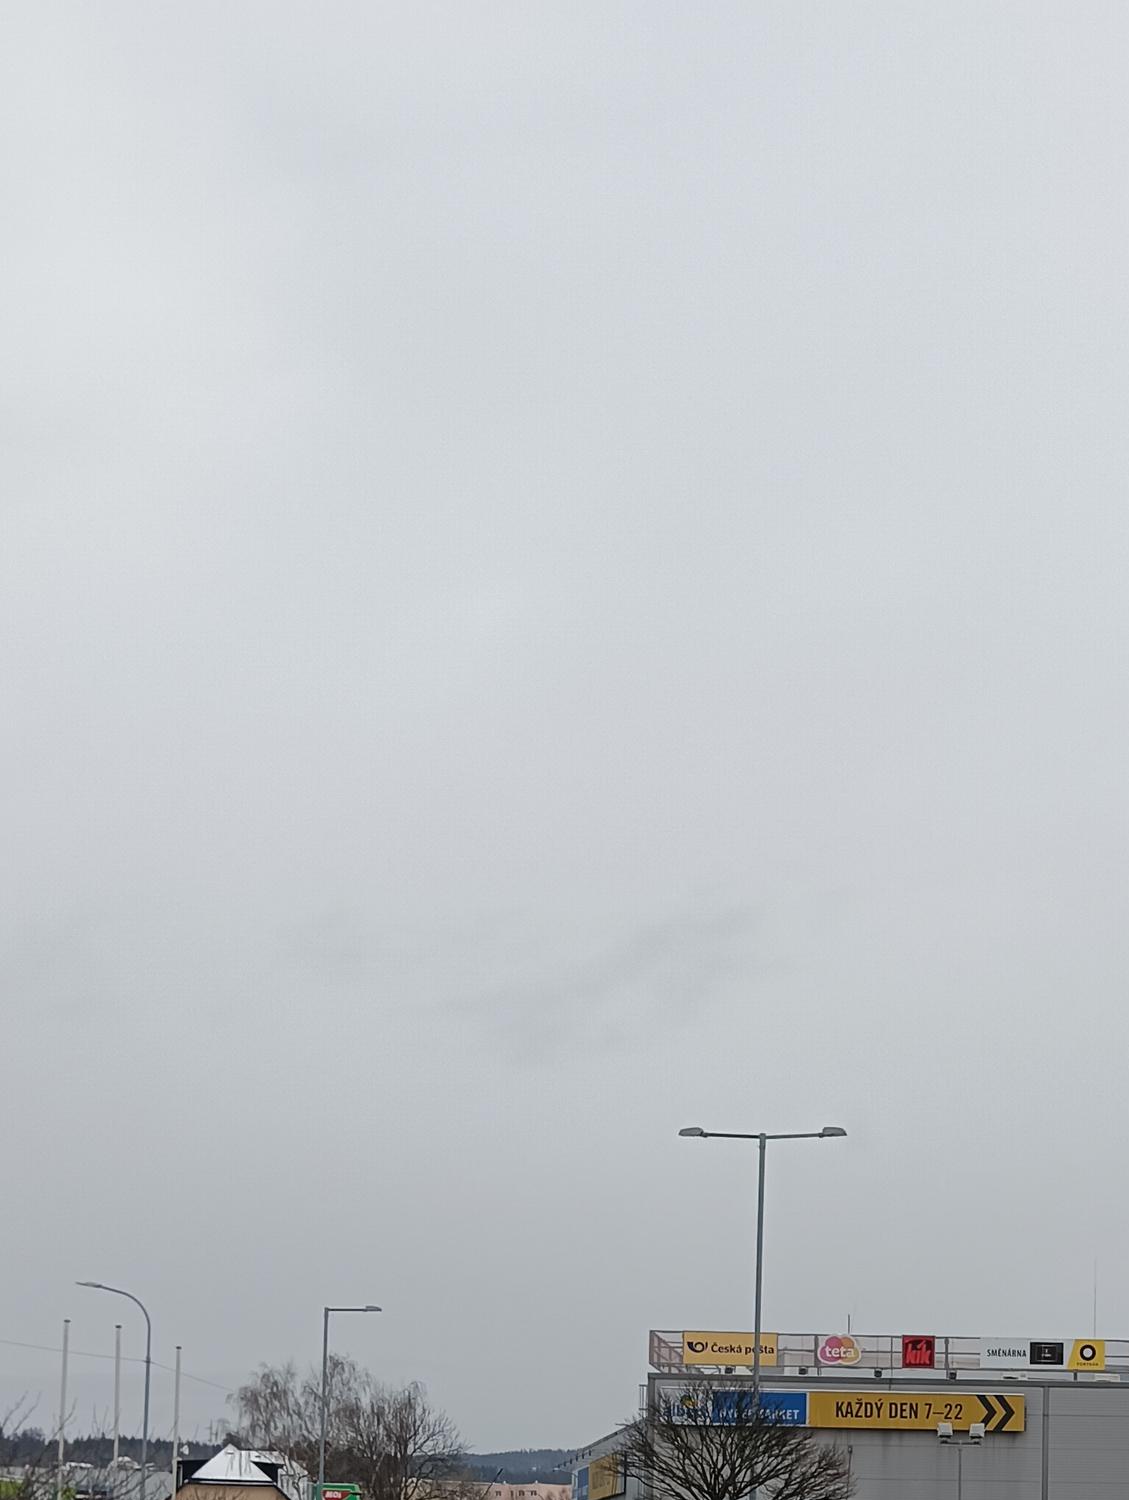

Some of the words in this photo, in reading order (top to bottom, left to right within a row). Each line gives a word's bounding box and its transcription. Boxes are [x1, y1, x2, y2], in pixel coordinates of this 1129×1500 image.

[711, 1342, 742, 1354] Česká
[825, 1346, 855, 1358] teta
[835, 1397, 884, 1419] KAŽDÝ
[888, 1401, 919, 1419] DEN
